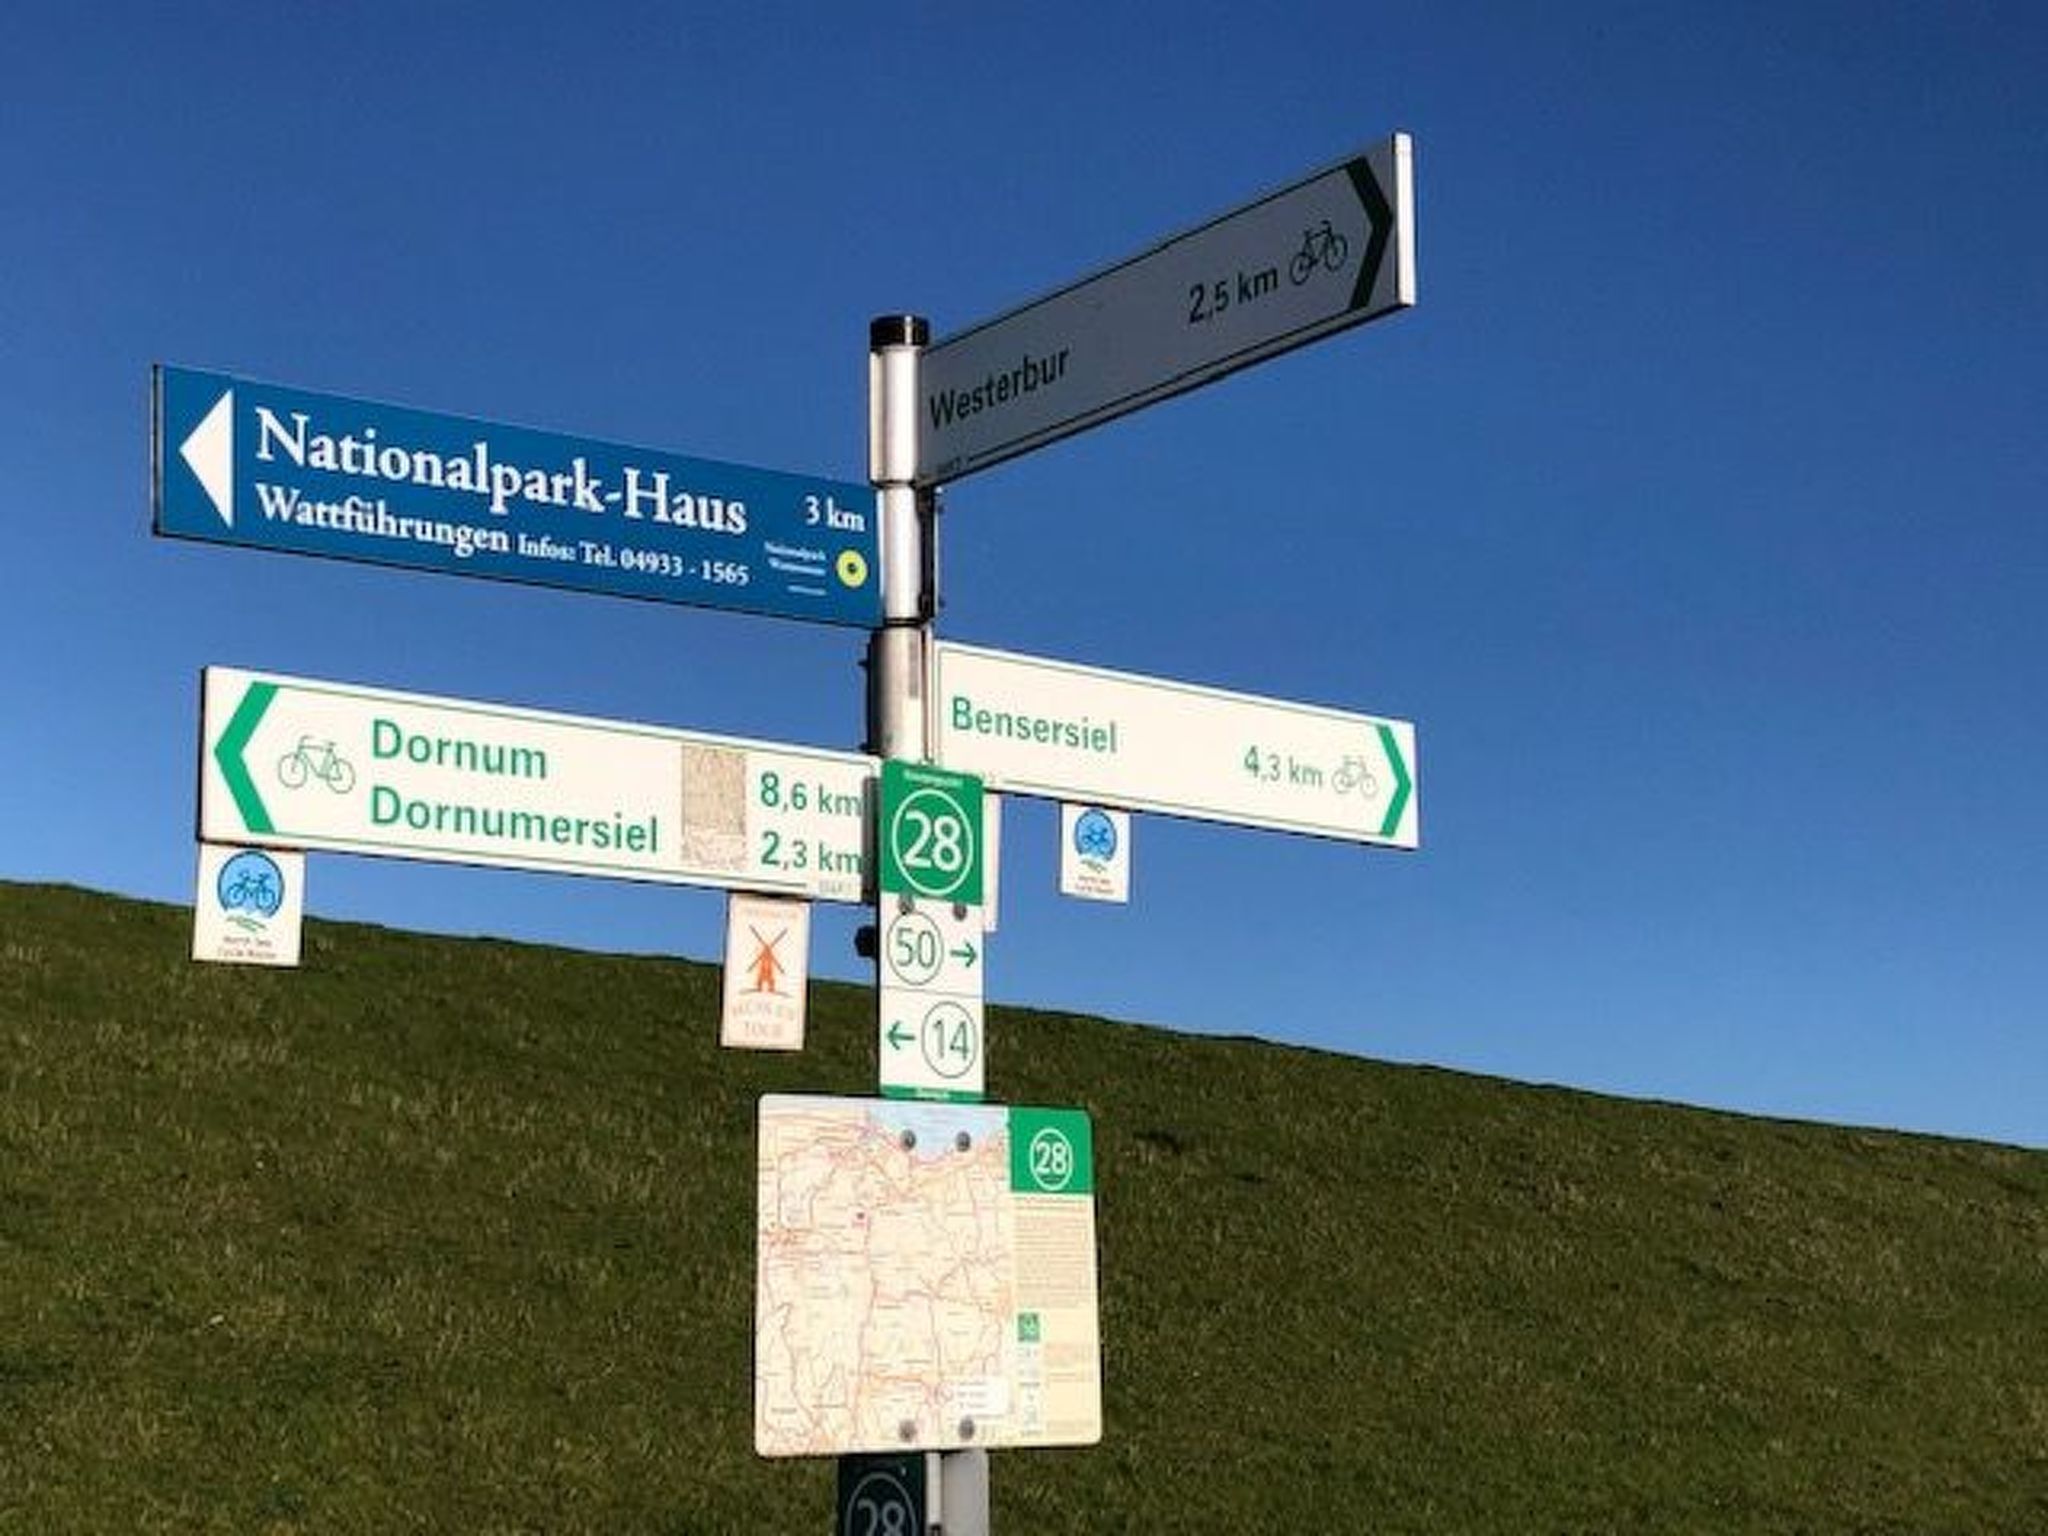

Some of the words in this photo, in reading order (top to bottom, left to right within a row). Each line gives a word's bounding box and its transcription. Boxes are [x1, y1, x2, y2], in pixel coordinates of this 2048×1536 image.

[930, 346, 1070, 430] Westerbur
[1189, 282, 1230, 323] 2,5
[1237, 267, 1278, 305] km
[255, 405, 749, 536] Nationalpark-Haus
[805, 494, 821, 526] 3
[826, 496, 866, 533] km
[255, 482, 511, 559] Wattführungen
[518, 532, 577, 562] Infos:
[579, 539, 617, 568] Tel.
[619, 548, 684, 577] 04933
[702, 559, 751, 586] 1565
[372, 718, 548, 780] Dornum
[760, 770, 808, 813] 8,6
[818, 782, 863, 817] km
[952, 696, 1118, 754] Bensersiel
[1244, 744, 1282, 783] 4,3
[1288, 754, 1324, 788] km
[371, 784, 659, 854] Dornumersiel
[760, 830, 808, 871] 2,3
[818, 840, 864, 875] km
[903, 809, 963, 873] 28
[895, 927, 936, 970] 50
[931, 1018, 969, 1062] 14
[1035, 1140, 1068, 1175] 28
[856, 1497, 905, 1536] 28
